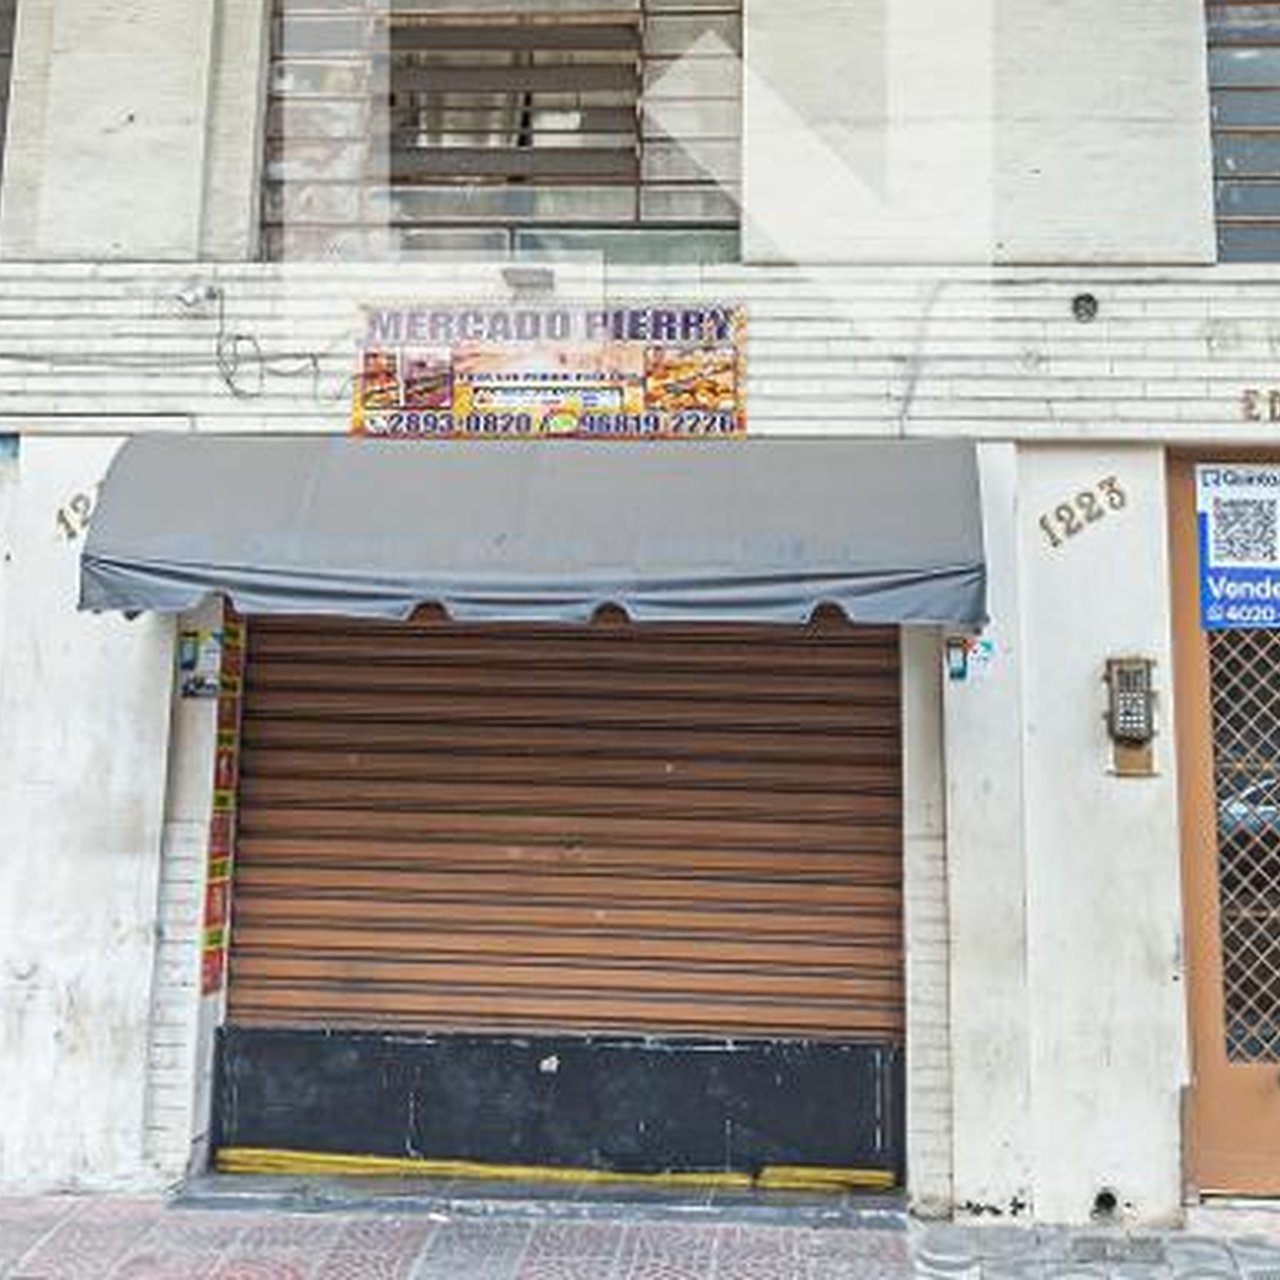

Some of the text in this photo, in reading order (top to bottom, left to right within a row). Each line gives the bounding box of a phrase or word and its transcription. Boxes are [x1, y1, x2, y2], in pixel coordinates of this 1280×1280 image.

[370, 306, 735, 341] MERCADO PIERRY
[1039, 476, 1126, 547] 1223
